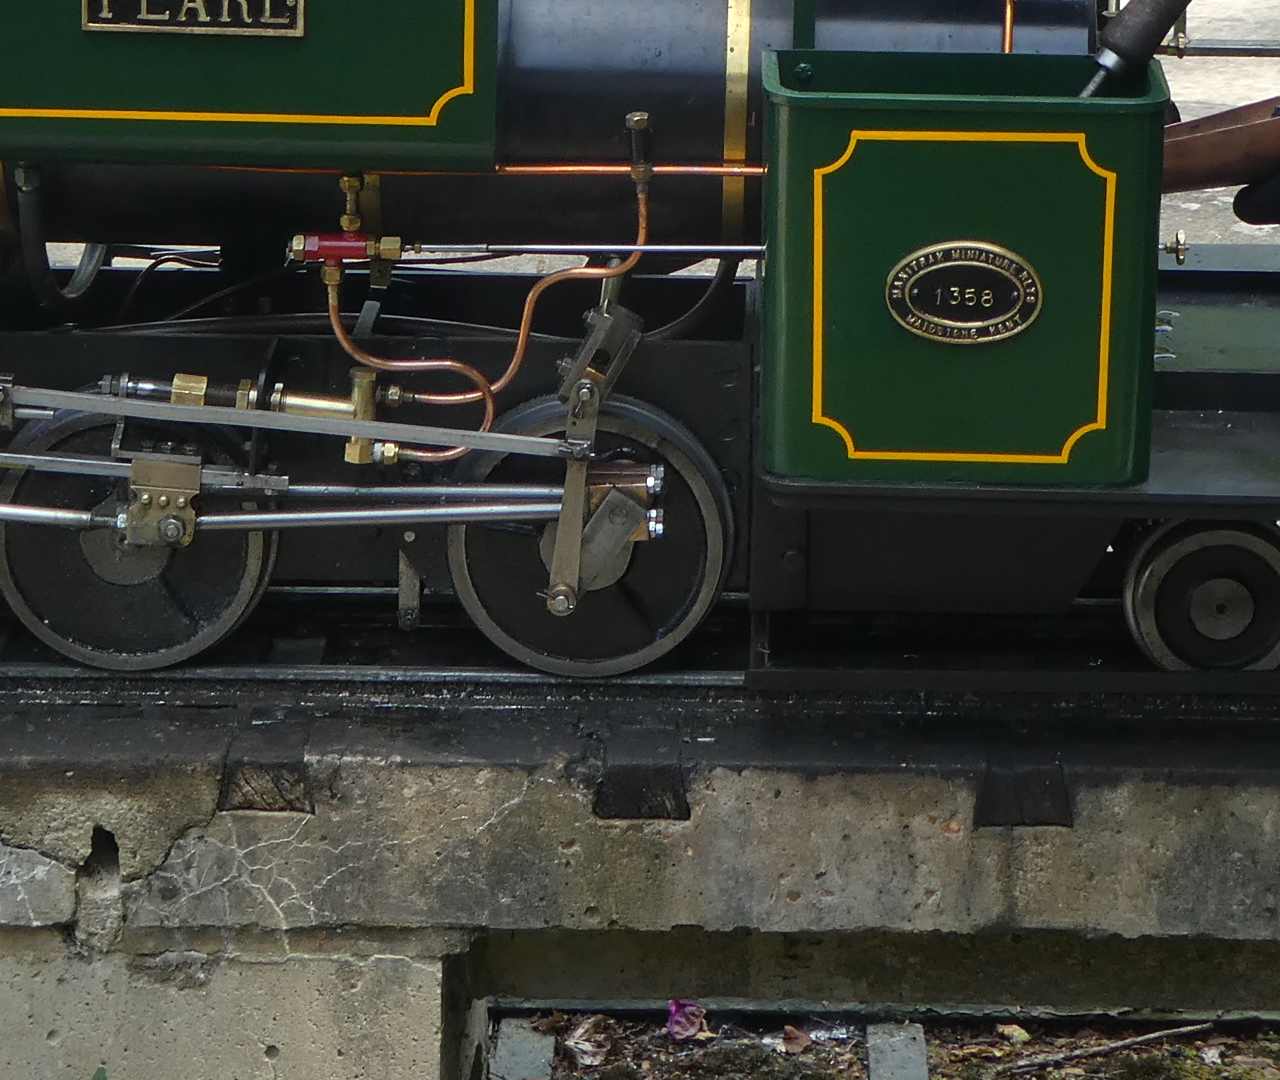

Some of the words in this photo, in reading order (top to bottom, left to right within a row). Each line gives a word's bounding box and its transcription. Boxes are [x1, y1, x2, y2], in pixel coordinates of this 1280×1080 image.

[951, 249, 1019, 275] MINIATURE
[935, 287, 994, 307] 1358
[905, 313, 979, 339] MAIDSTONE
[989, 314, 1023, 335] KENT
